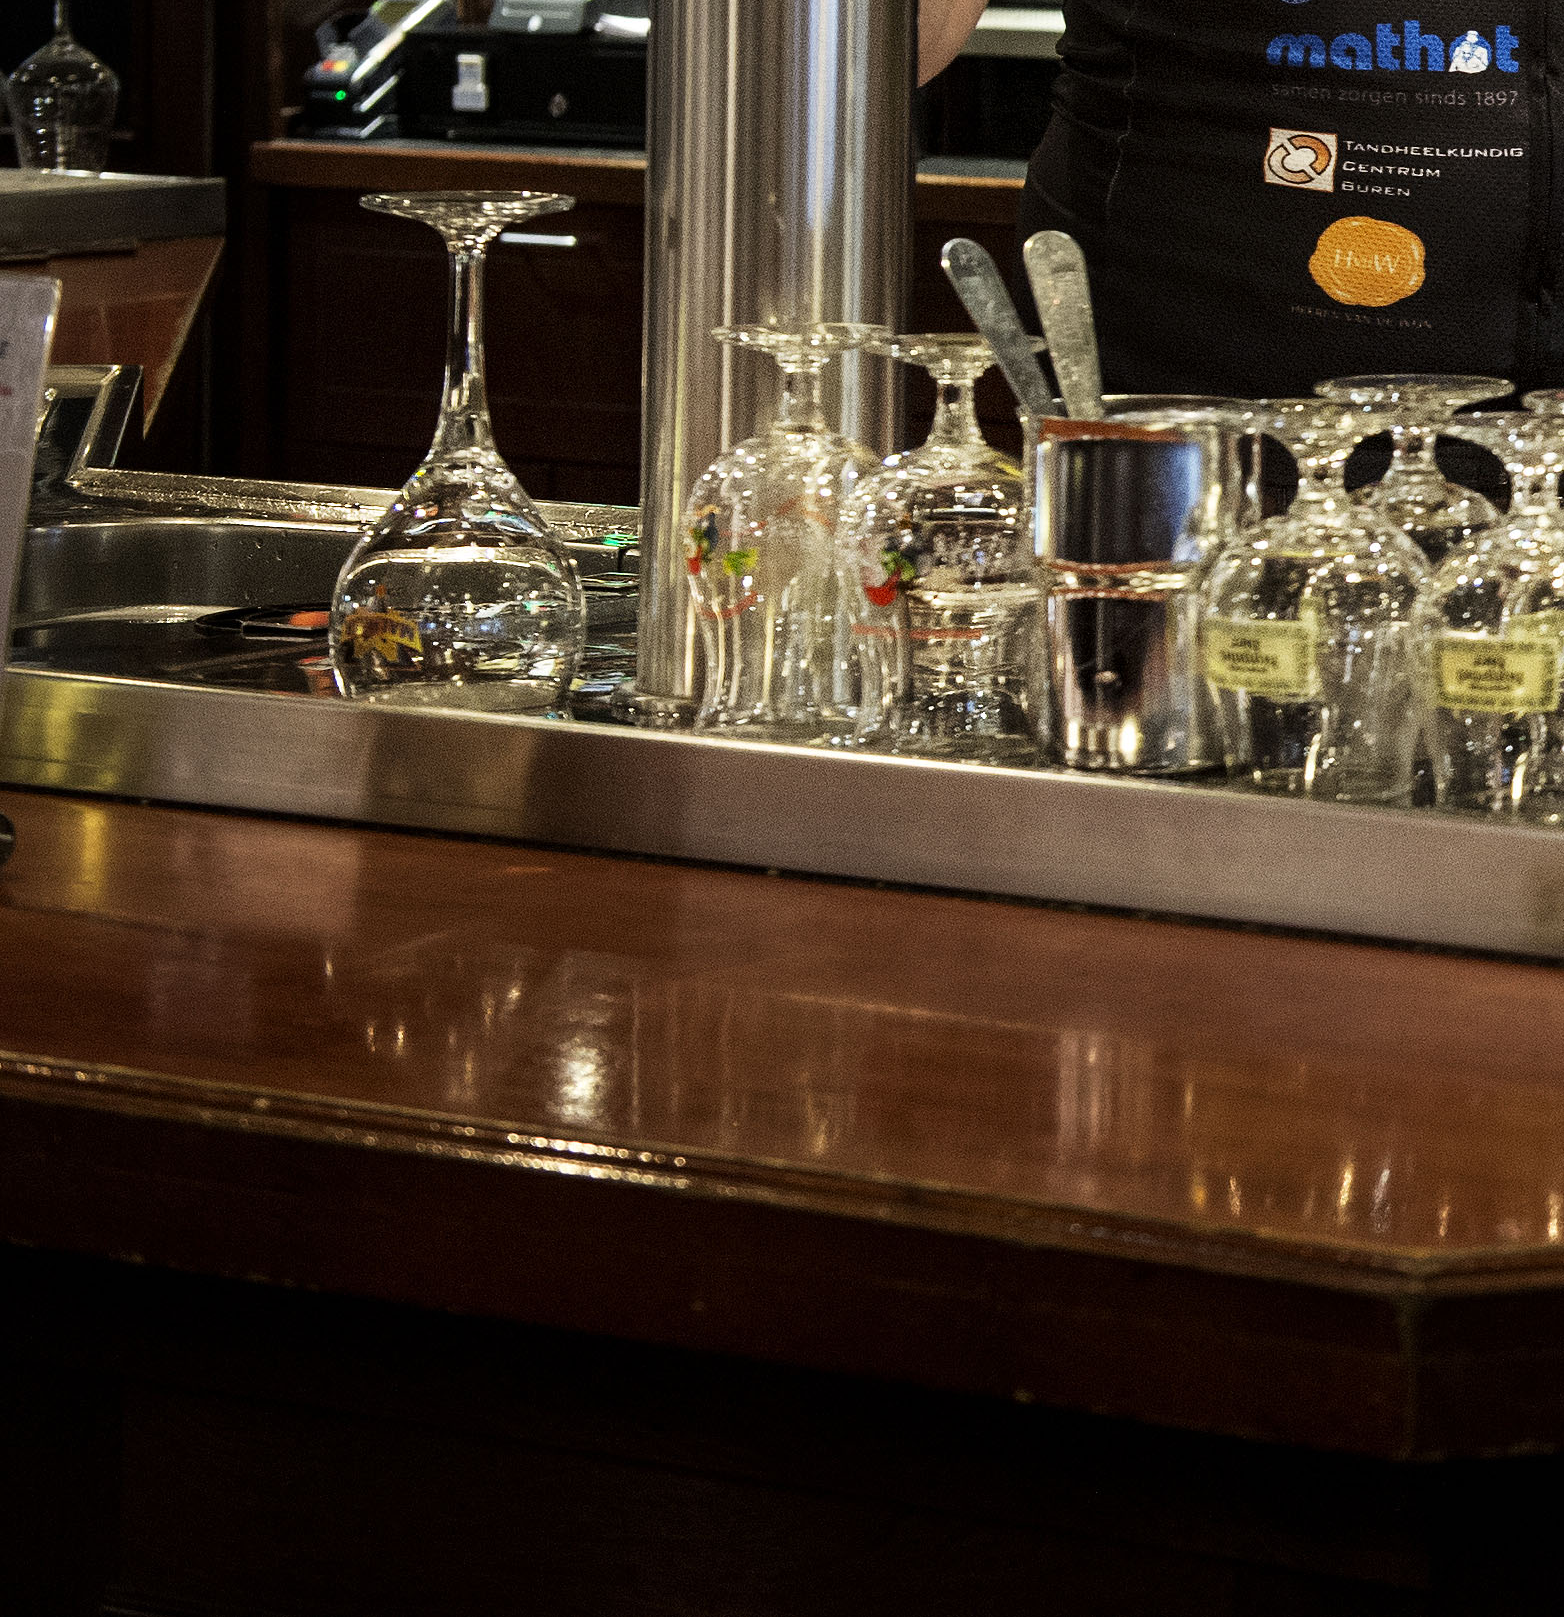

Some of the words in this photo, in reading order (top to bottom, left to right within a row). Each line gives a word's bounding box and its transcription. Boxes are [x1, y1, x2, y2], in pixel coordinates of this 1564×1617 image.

[1266, 19, 1520, 73] mathot
[1415, 89, 1467, 106] sinds
[1476, 90, 1520, 107] 1897
[1343, 140, 1525, 158] TANDHEELKUNDIG
[1341, 161, 1442, 178] CENTRUM
[1341, 181, 1411, 197] BUREN
